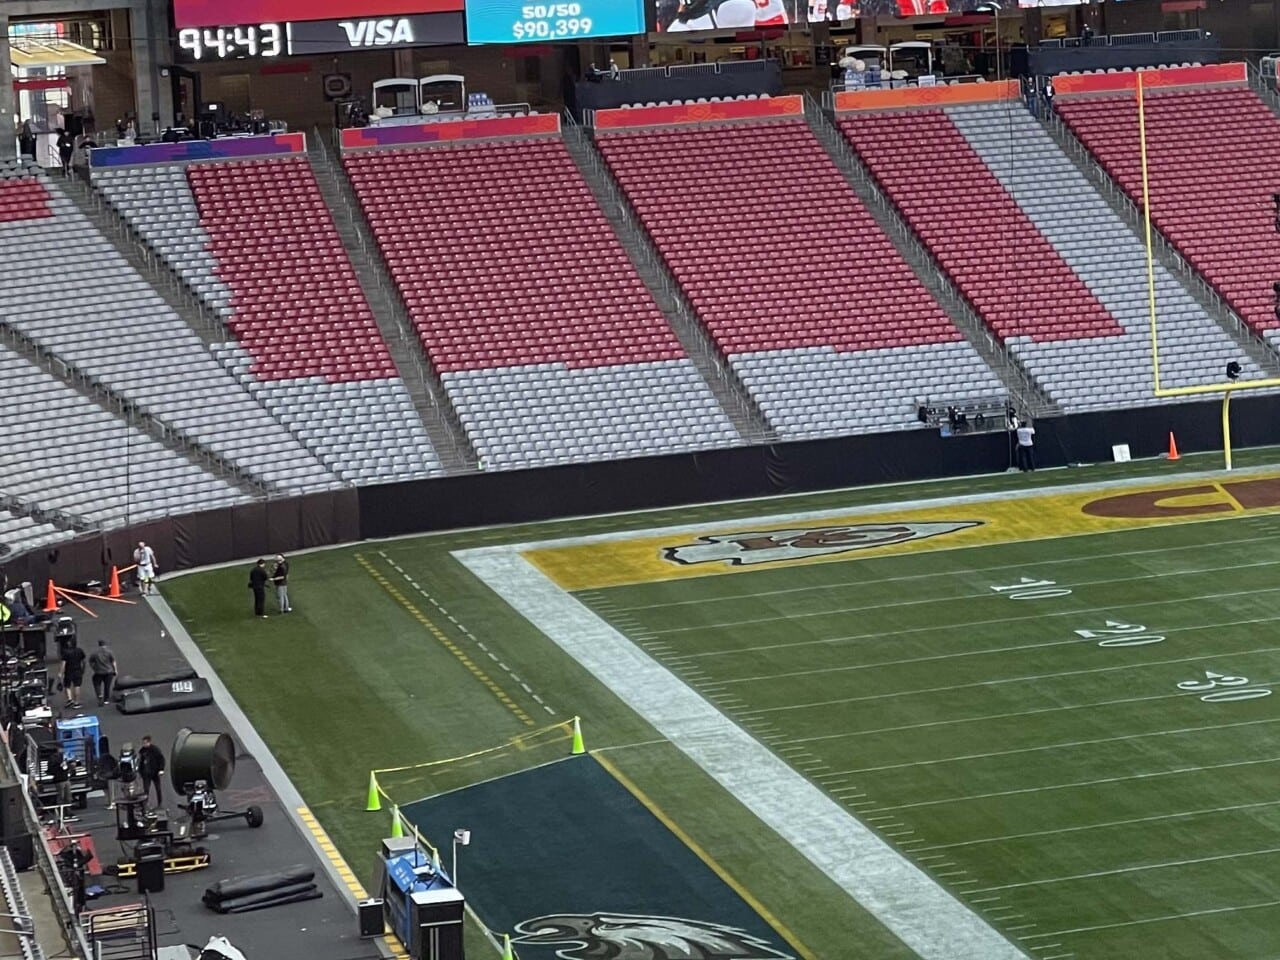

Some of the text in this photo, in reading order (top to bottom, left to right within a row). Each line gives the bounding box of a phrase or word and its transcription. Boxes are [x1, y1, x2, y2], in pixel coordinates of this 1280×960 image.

[522, 3, 581, 19] 50/50
[178, 22, 282, 60] 94:43
[338, 18, 416, 47] VISA
[512, 18, 593, 39] $90,399
[991, 580, 1073, 600] 10
[1074, 623, 1166, 648] 20
[1176, 676, 1273, 703] 30
